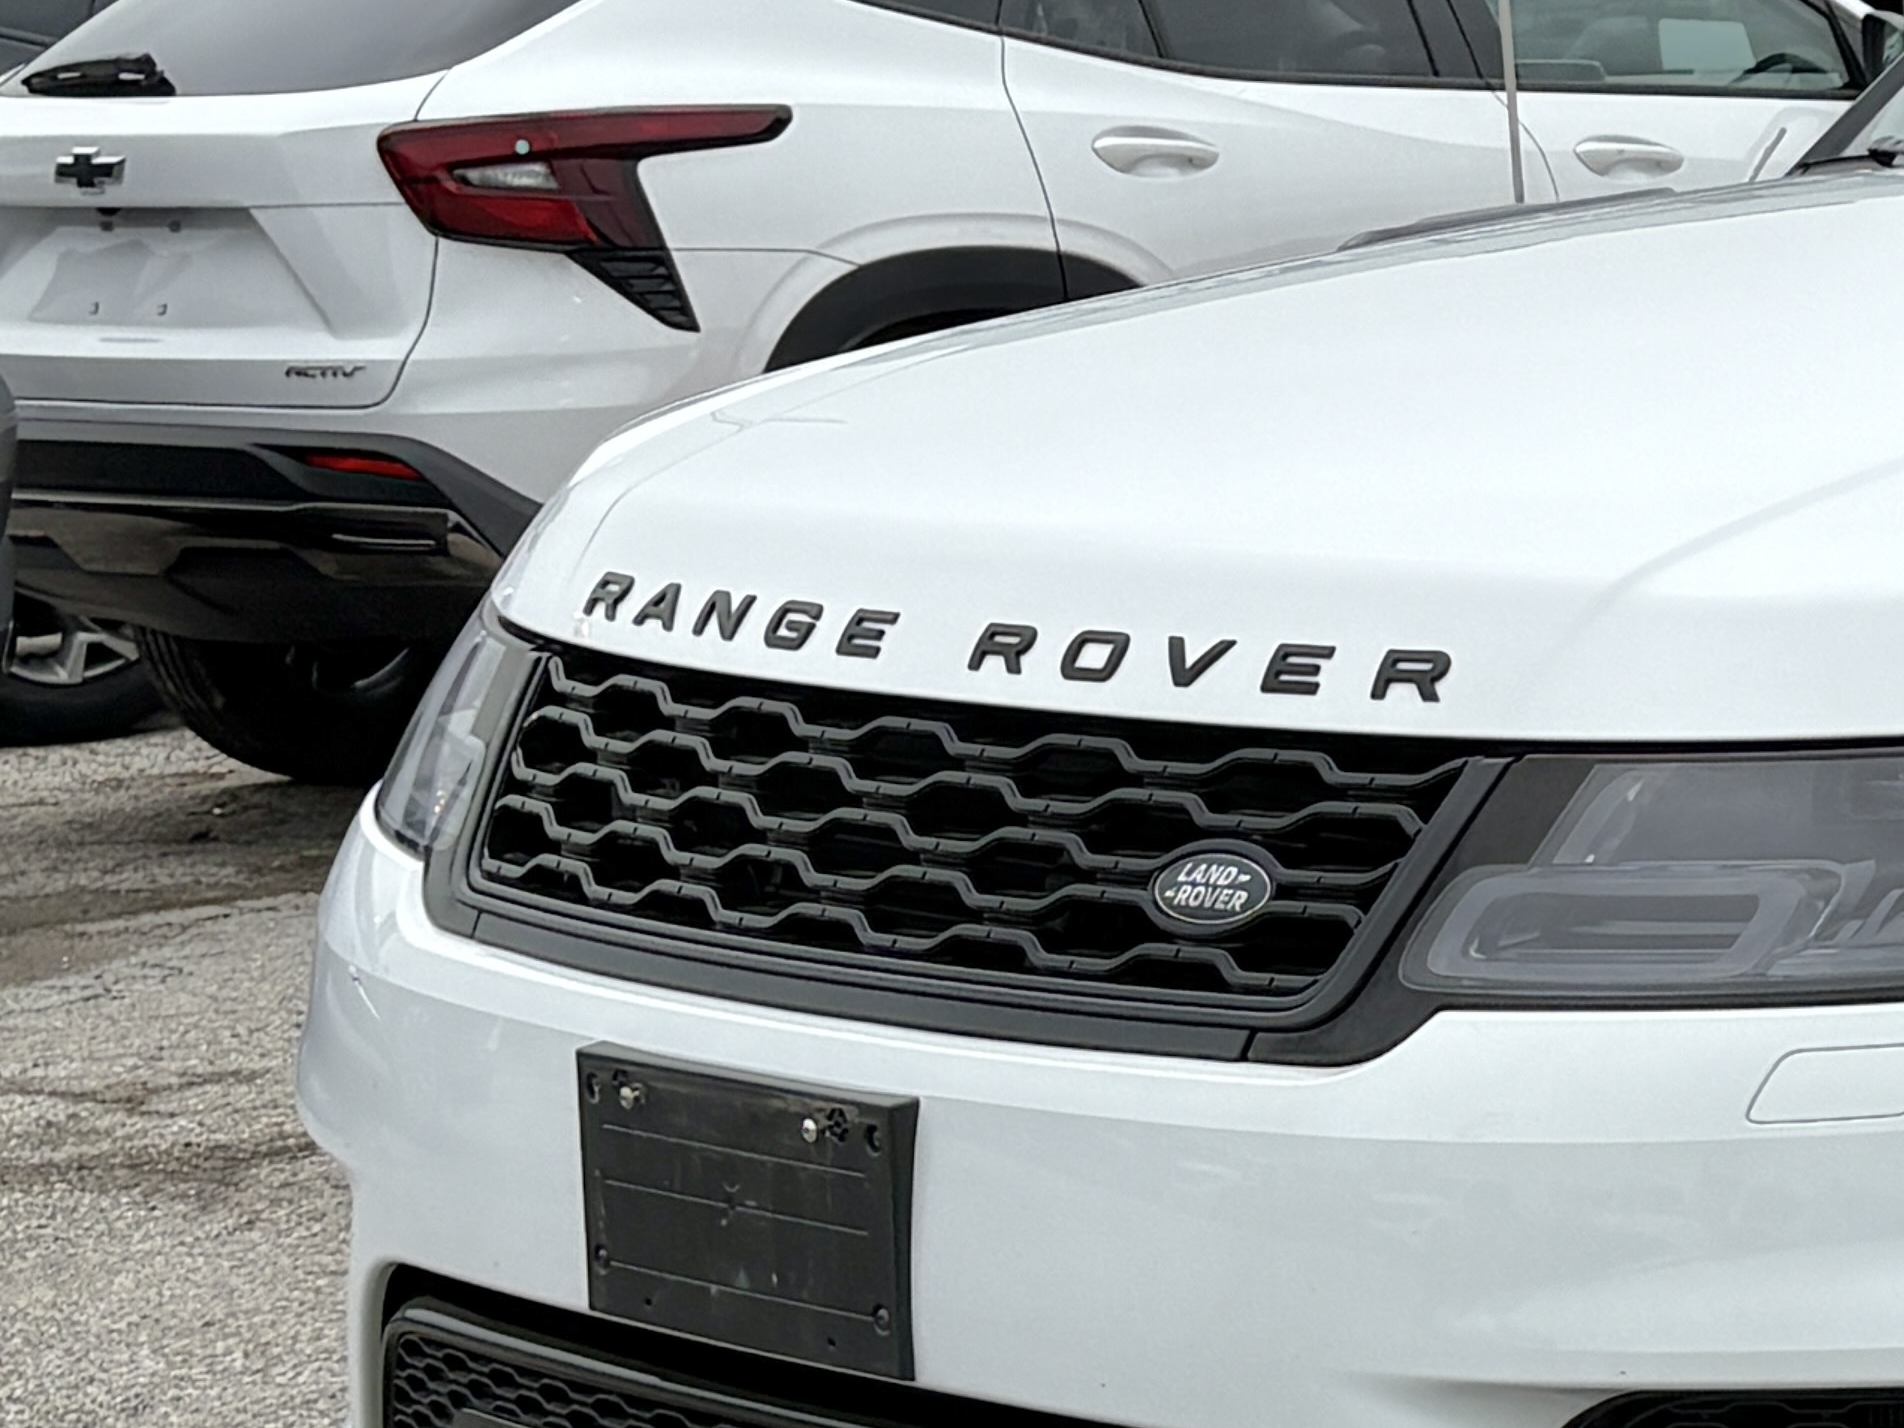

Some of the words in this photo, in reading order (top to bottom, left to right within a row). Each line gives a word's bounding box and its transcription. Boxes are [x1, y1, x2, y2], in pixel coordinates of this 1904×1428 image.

[285, 365, 366, 378] ACTIV
[583, 571, 900, 660] RANGE
[967, 621, 1453, 703] ROVER
[1177, 862, 1238, 885] LAND
[1172, 884, 1249, 911] ROVER
